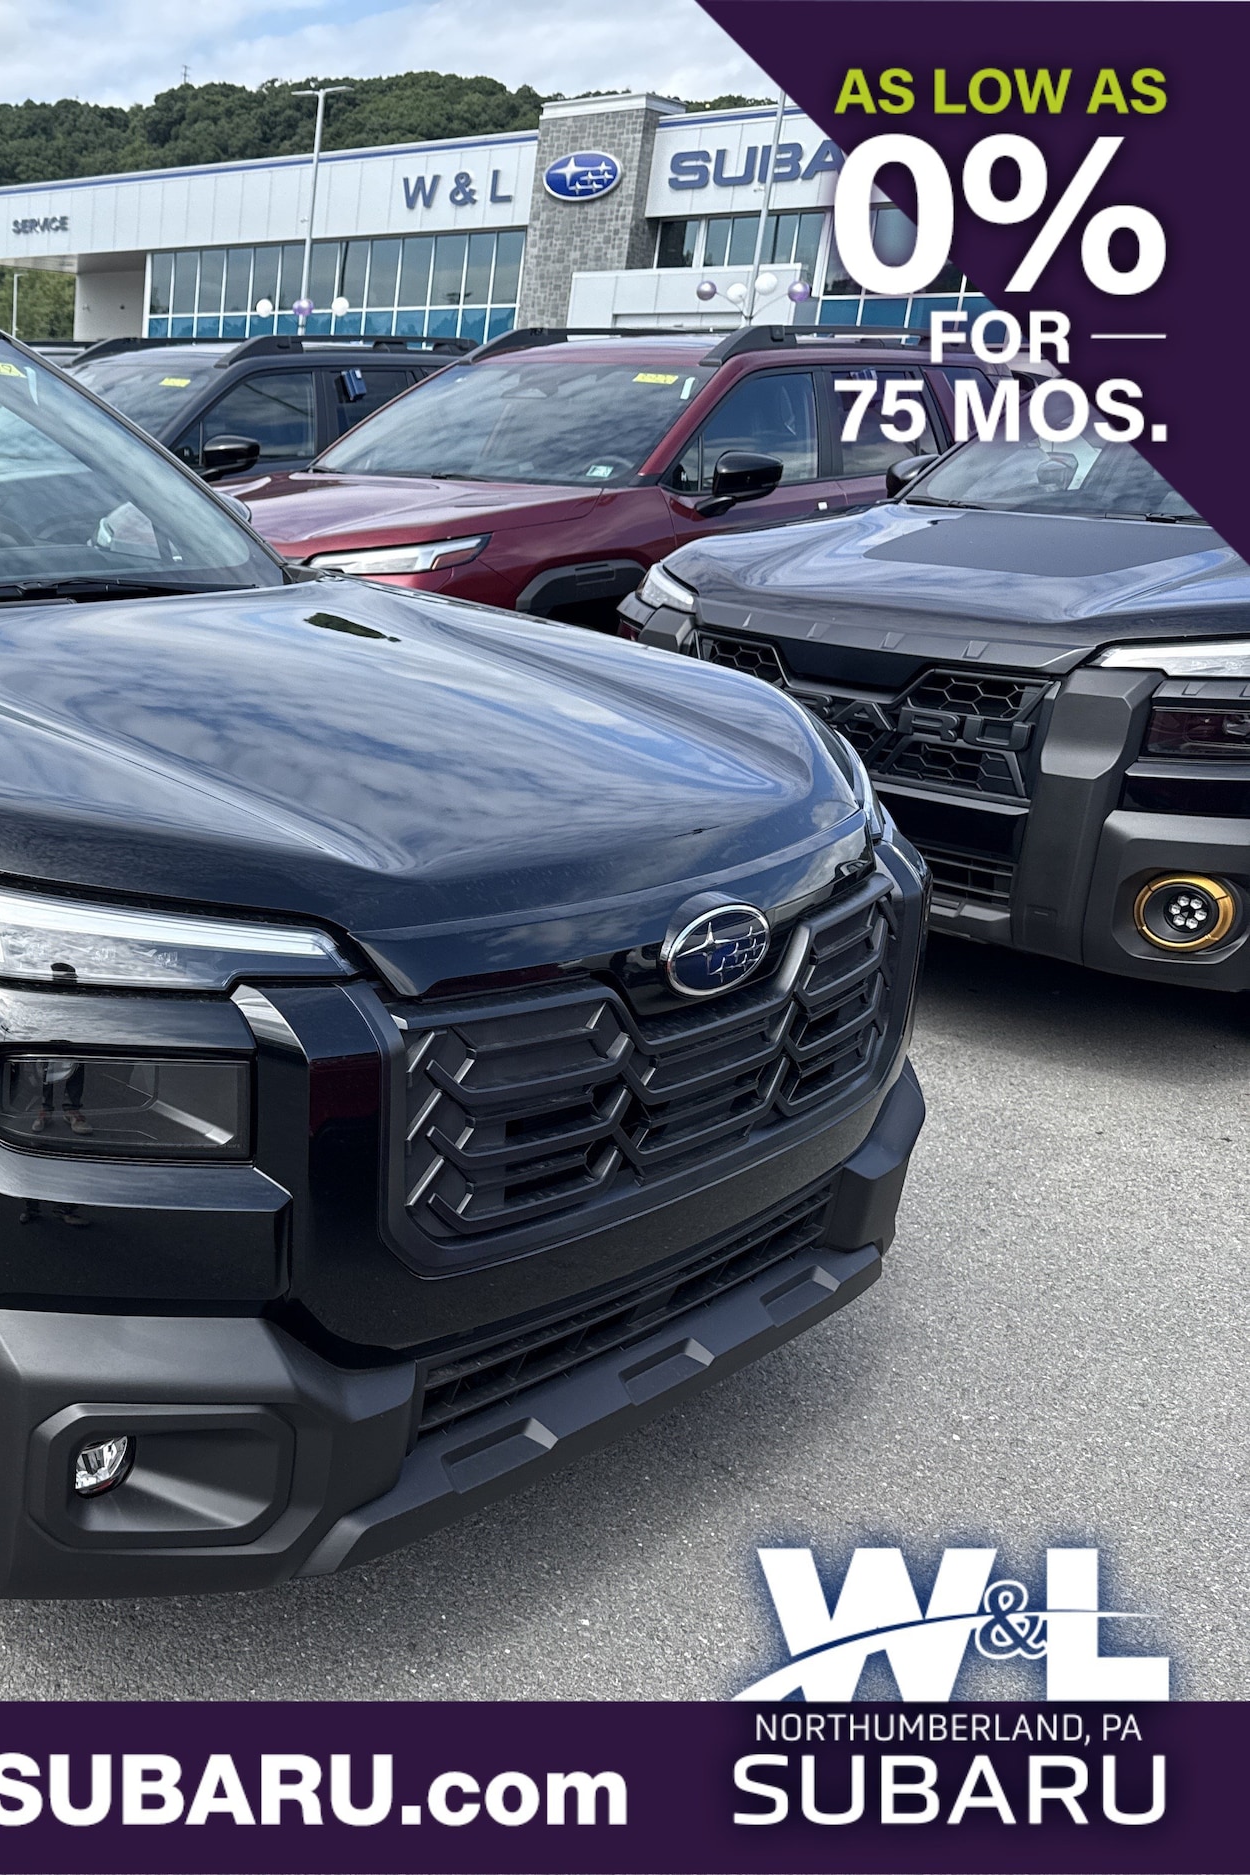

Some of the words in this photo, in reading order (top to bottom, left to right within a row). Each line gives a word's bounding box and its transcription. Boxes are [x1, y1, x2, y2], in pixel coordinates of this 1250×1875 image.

[668, 139, 847, 191] SUBA
[402, 174, 441, 210] W
[449, 171, 477, 207] &
[490, 169, 513, 203] L
[11, 216, 69, 235] SERVICE
[786, 688, 1033, 751] BARU
